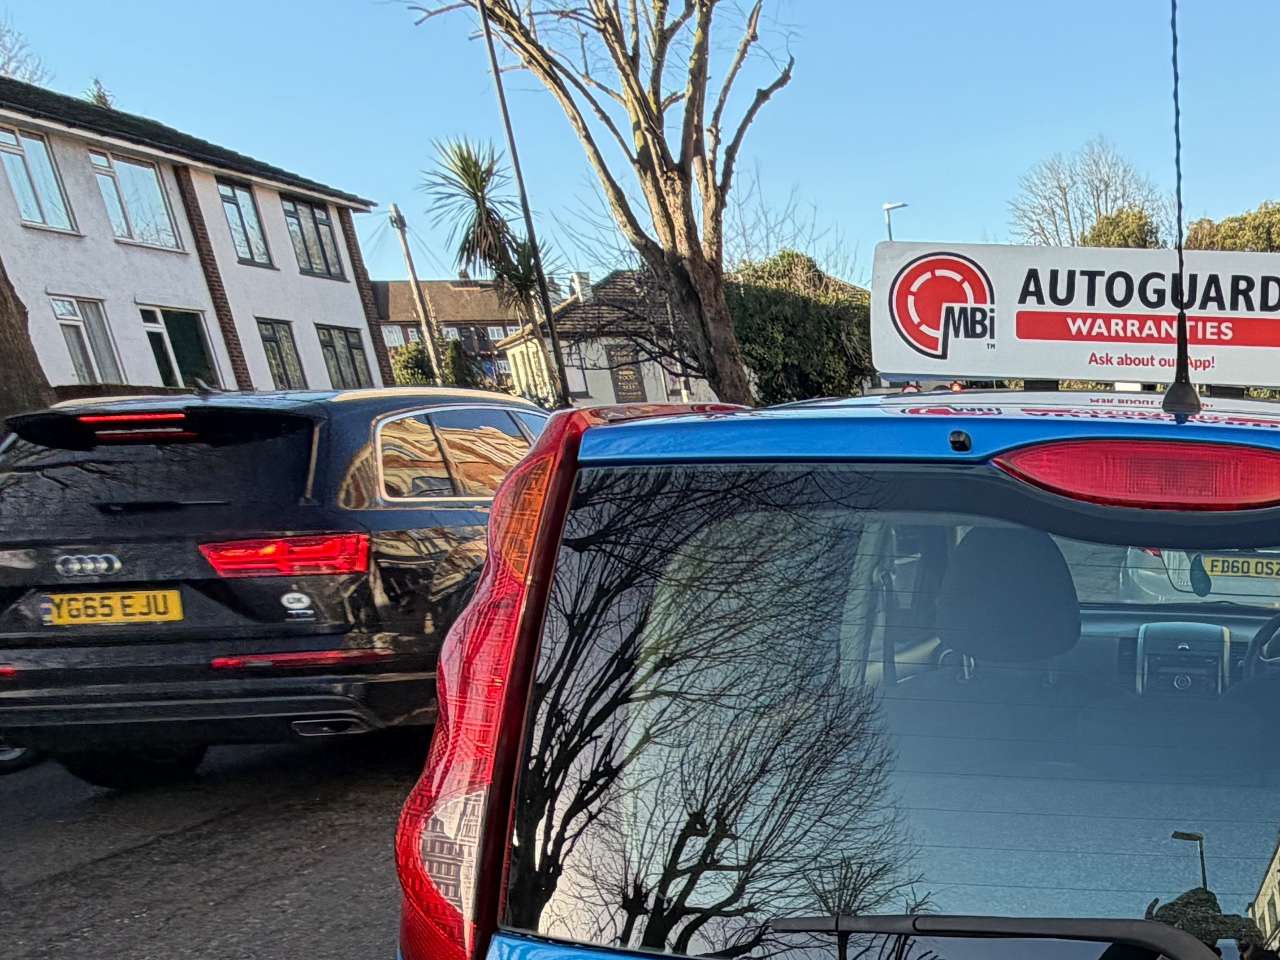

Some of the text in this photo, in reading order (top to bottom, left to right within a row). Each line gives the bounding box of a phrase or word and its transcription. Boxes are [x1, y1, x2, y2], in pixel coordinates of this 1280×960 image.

[942, 306, 995, 360] MBi
[1066, 317, 1233, 340] WARRANTIES
[1088, 352, 1114, 366] Ask
[1116, 353, 1154, 368] about
[1158, 357, 1182, 368] ou
[120, 594, 169, 617] EJU
